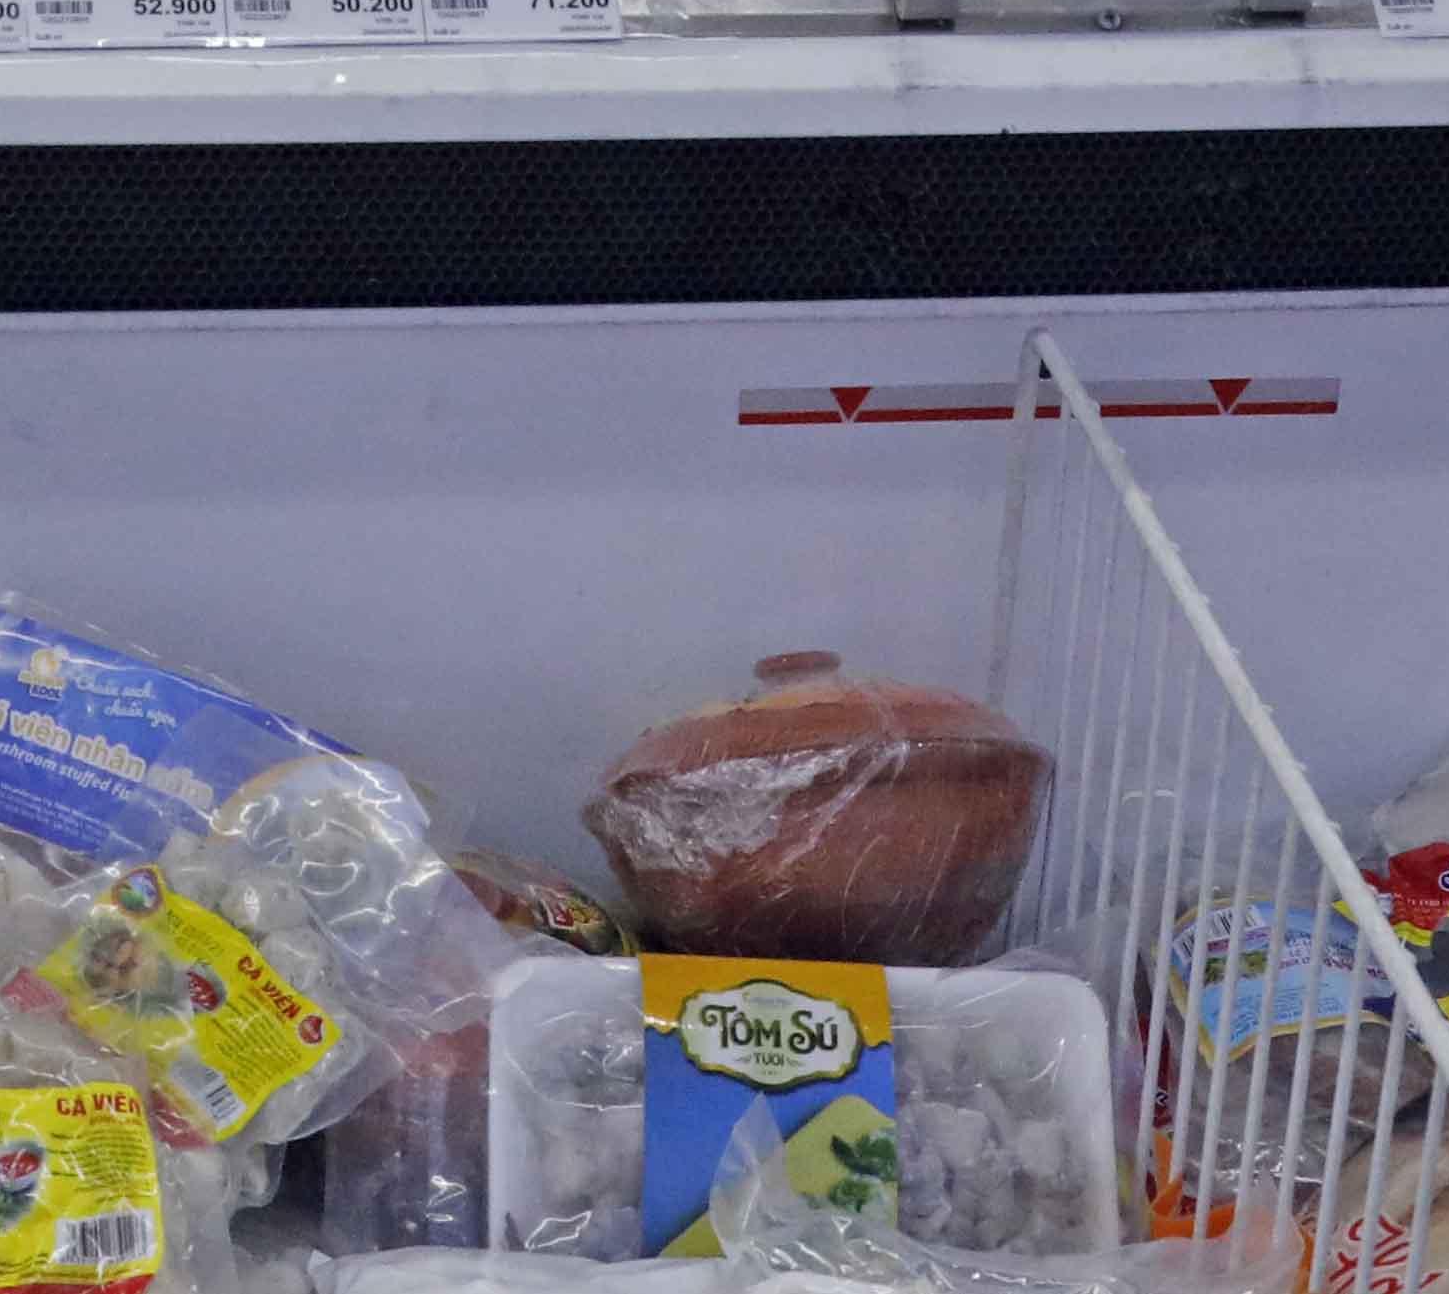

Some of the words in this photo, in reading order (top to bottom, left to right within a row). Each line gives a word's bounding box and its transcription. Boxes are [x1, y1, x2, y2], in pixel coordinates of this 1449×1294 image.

[8, 709, 72, 754] viên
[71, 734, 147, 783] nhân
[59, 762, 111, 794] stuffed
